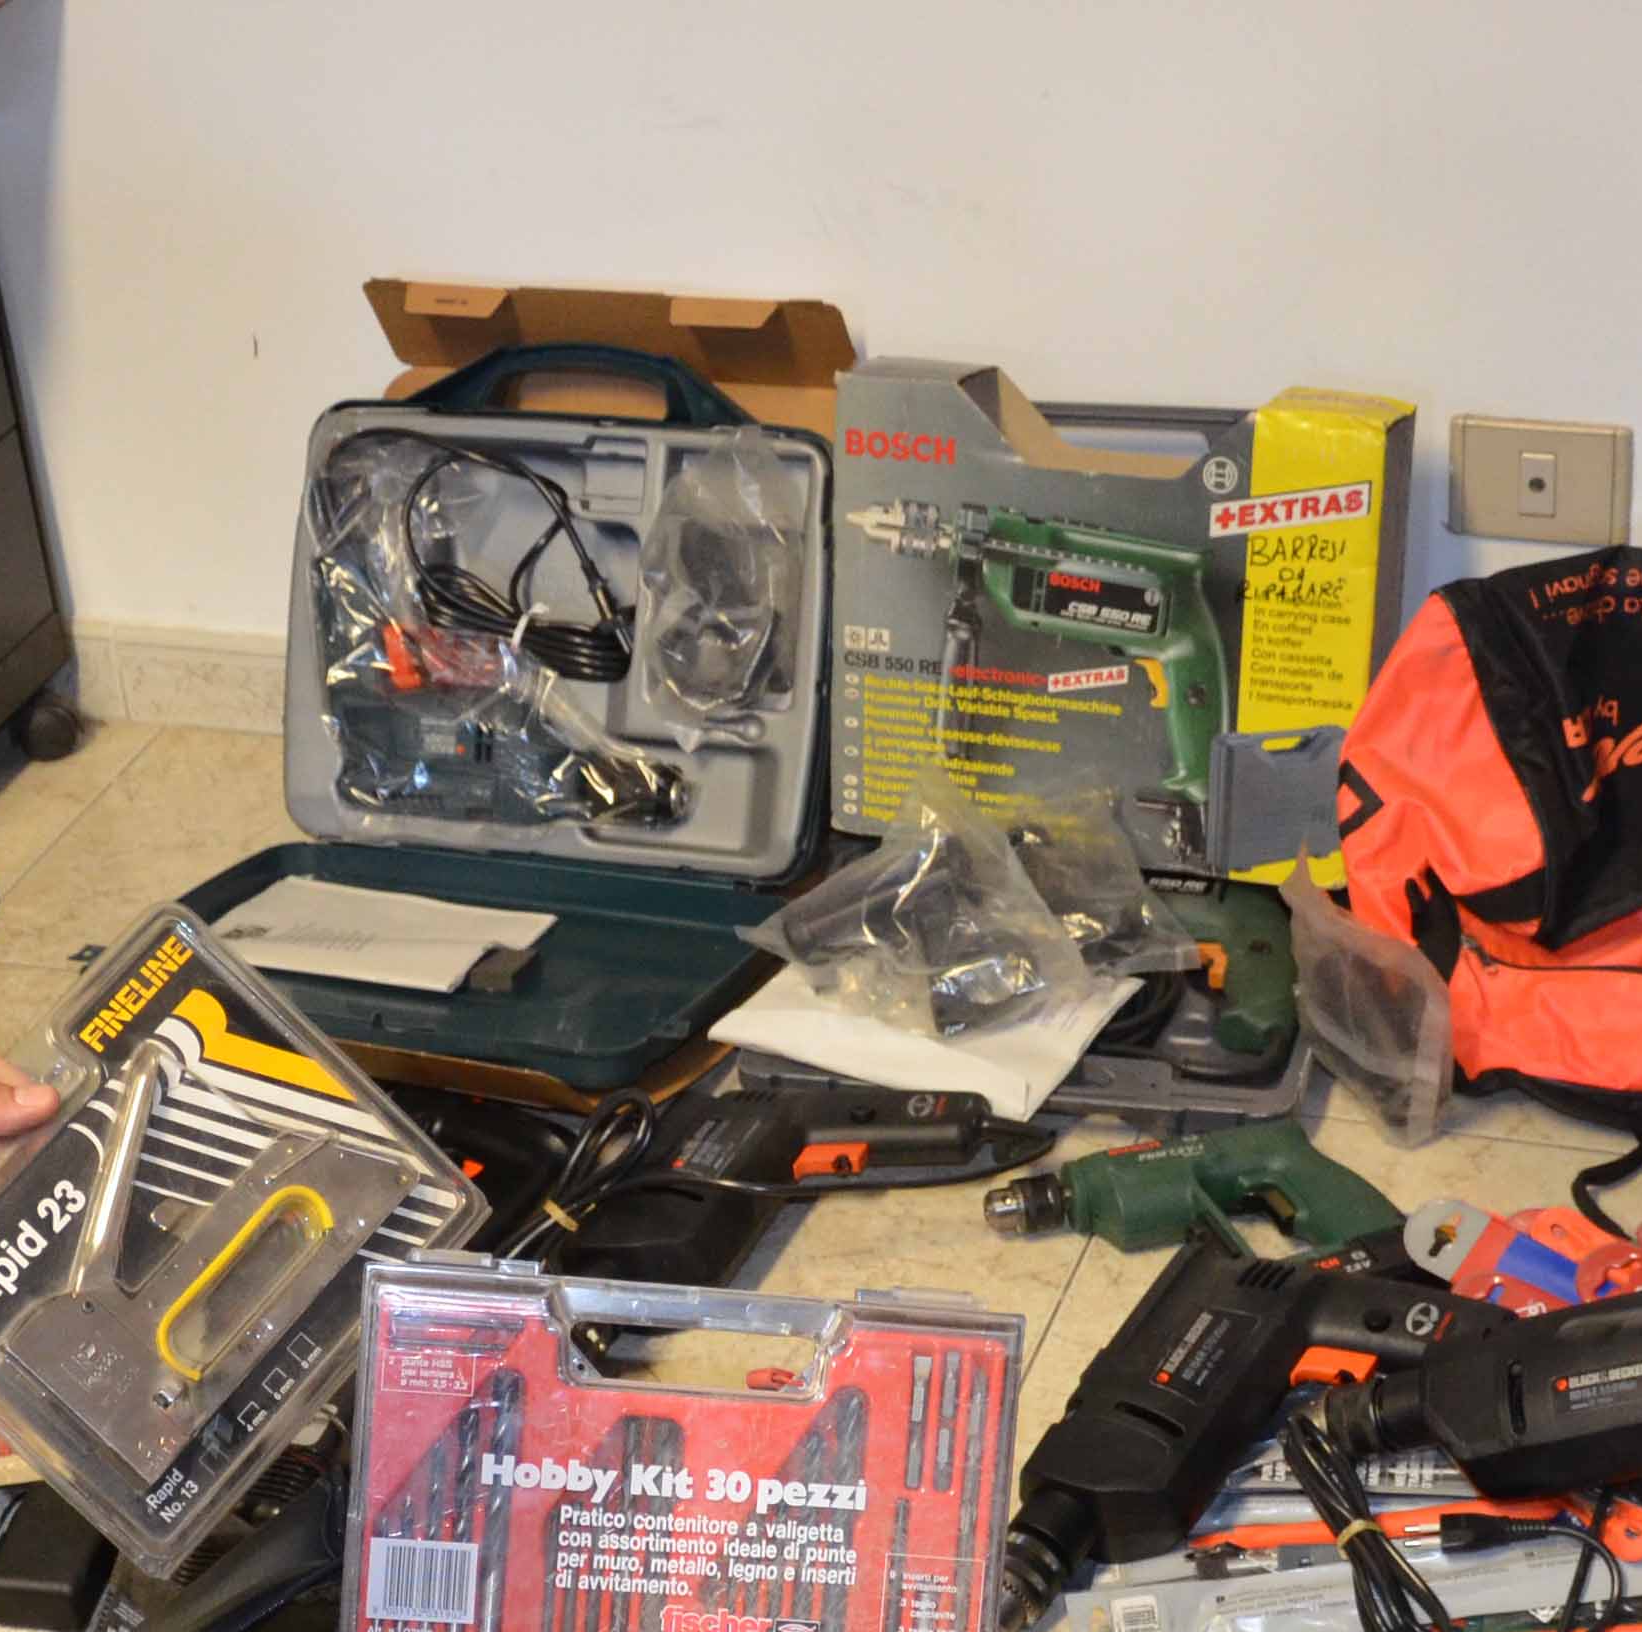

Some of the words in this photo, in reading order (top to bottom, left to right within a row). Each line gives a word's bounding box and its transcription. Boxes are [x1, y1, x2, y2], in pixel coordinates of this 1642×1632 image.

[844, 426, 958, 466] BOSCH
[1048, 571, 1102, 593] BOSCH
[843, 651, 881, 667] CSB
[884, 654, 914, 672] 550
[78, 934, 194, 1053] FINELINE
[36, 1180, 87, 1234] 23
[400, 1369, 418, 1380] per
[401, 1358, 430, 1370] punte
[145, 1467, 185, 1510] Rapid
[159, 1499, 187, 1524] No.
[180, 1478, 200, 1500] 13
[481, 1453, 619, 1504] Hobby
[630, 1464, 695, 1500] Kit
[705, 1468, 752, 1503] 30
[755, 1477, 868, 1514] pezzi
[560, 1504, 627, 1530] Pratico
[633, 1511, 739, 1537] contenitore
[746, 1521, 758, 1537] a
[765, 1520, 845, 1546] valigetta
[558, 1531, 592, 1548] con
[597, 1532, 718, 1556] assortimento
[723, 1540, 778, 1561] ideale
[783, 1542, 801, 1562] di
[805, 1545, 858, 1567] punte
[555, 1569, 572, 1589] di
[577, 1572, 695, 1598] avvitamento.
[557, 1551, 588, 1572] per
[592, 1552, 645, 1576] muro,
[649, 1554, 723, 1580] metallo,
[727, 1559, 778, 1584] legno
[783, 1566, 795, 1581] e
[800, 1564, 858, 1586] inserti
[932, 1574, 950, 1585] per
[902, 1582, 958, 1594] avvitamento
